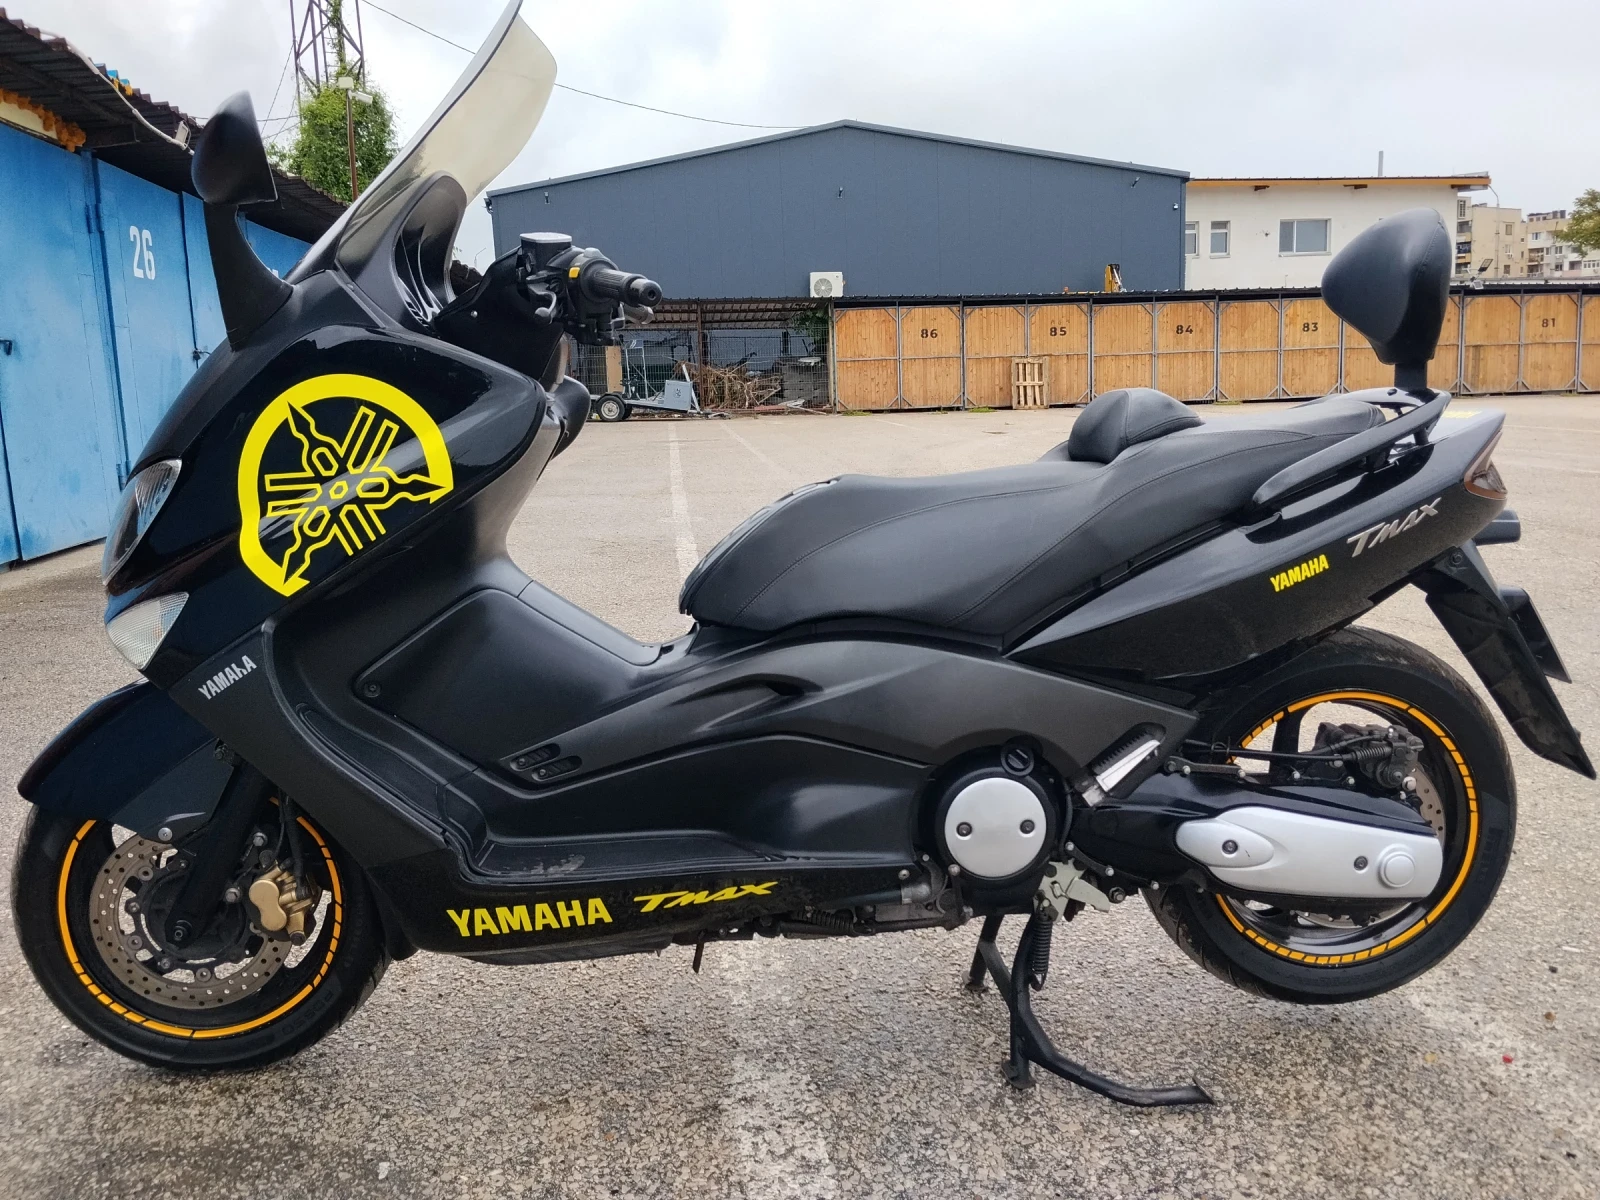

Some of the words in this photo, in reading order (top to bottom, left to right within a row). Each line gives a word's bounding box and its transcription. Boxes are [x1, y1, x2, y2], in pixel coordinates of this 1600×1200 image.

[130, 225, 155, 280] 26
[1302, 322, 1319, 332] 83
[1541, 317, 1556, 328] 81
[920, 328, 938, 339] 86
[1049, 326, 1067, 337] 85
[1175, 324, 1194, 335] 84
[1346, 497, 1442, 558] TMAX
[1270, 554, 1330, 592] YAMAHA
[446, 897, 613, 937] YAMAHA
[634, 881, 778, 913] TMAX
